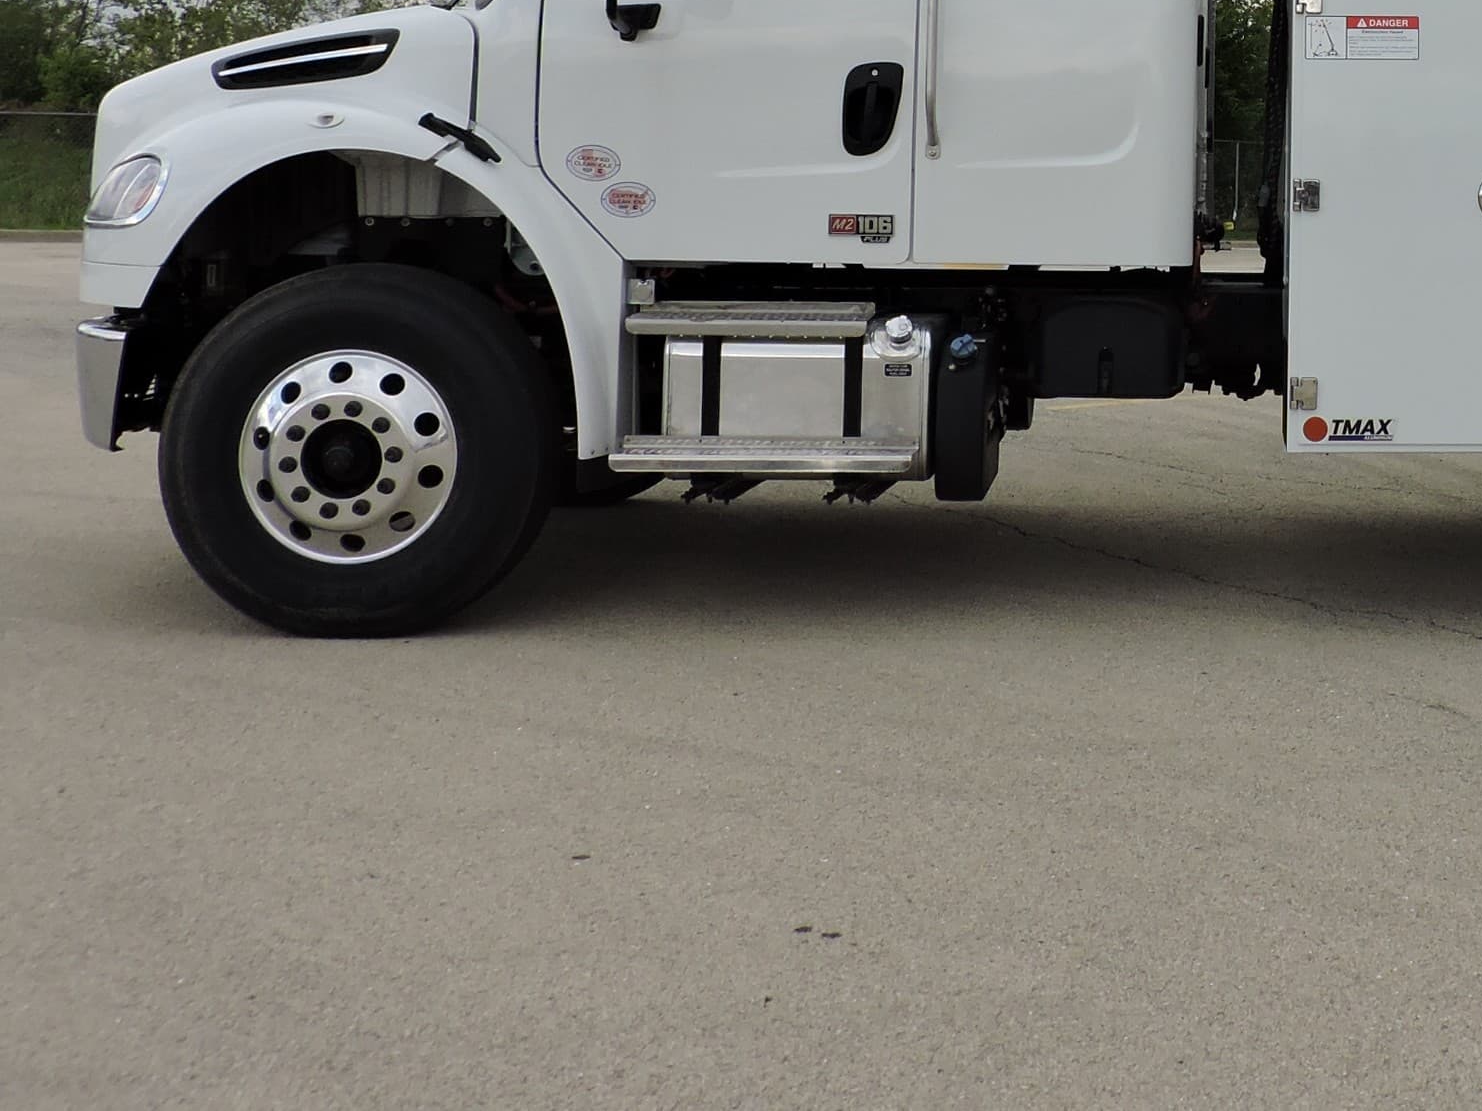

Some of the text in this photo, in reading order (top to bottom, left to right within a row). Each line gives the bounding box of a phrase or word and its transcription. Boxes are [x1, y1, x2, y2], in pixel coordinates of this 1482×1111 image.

[1369, 18, 1409, 27] DANGER
[832, 216, 892, 234] M2 106
[1332, 419, 1392, 435] TMAX
